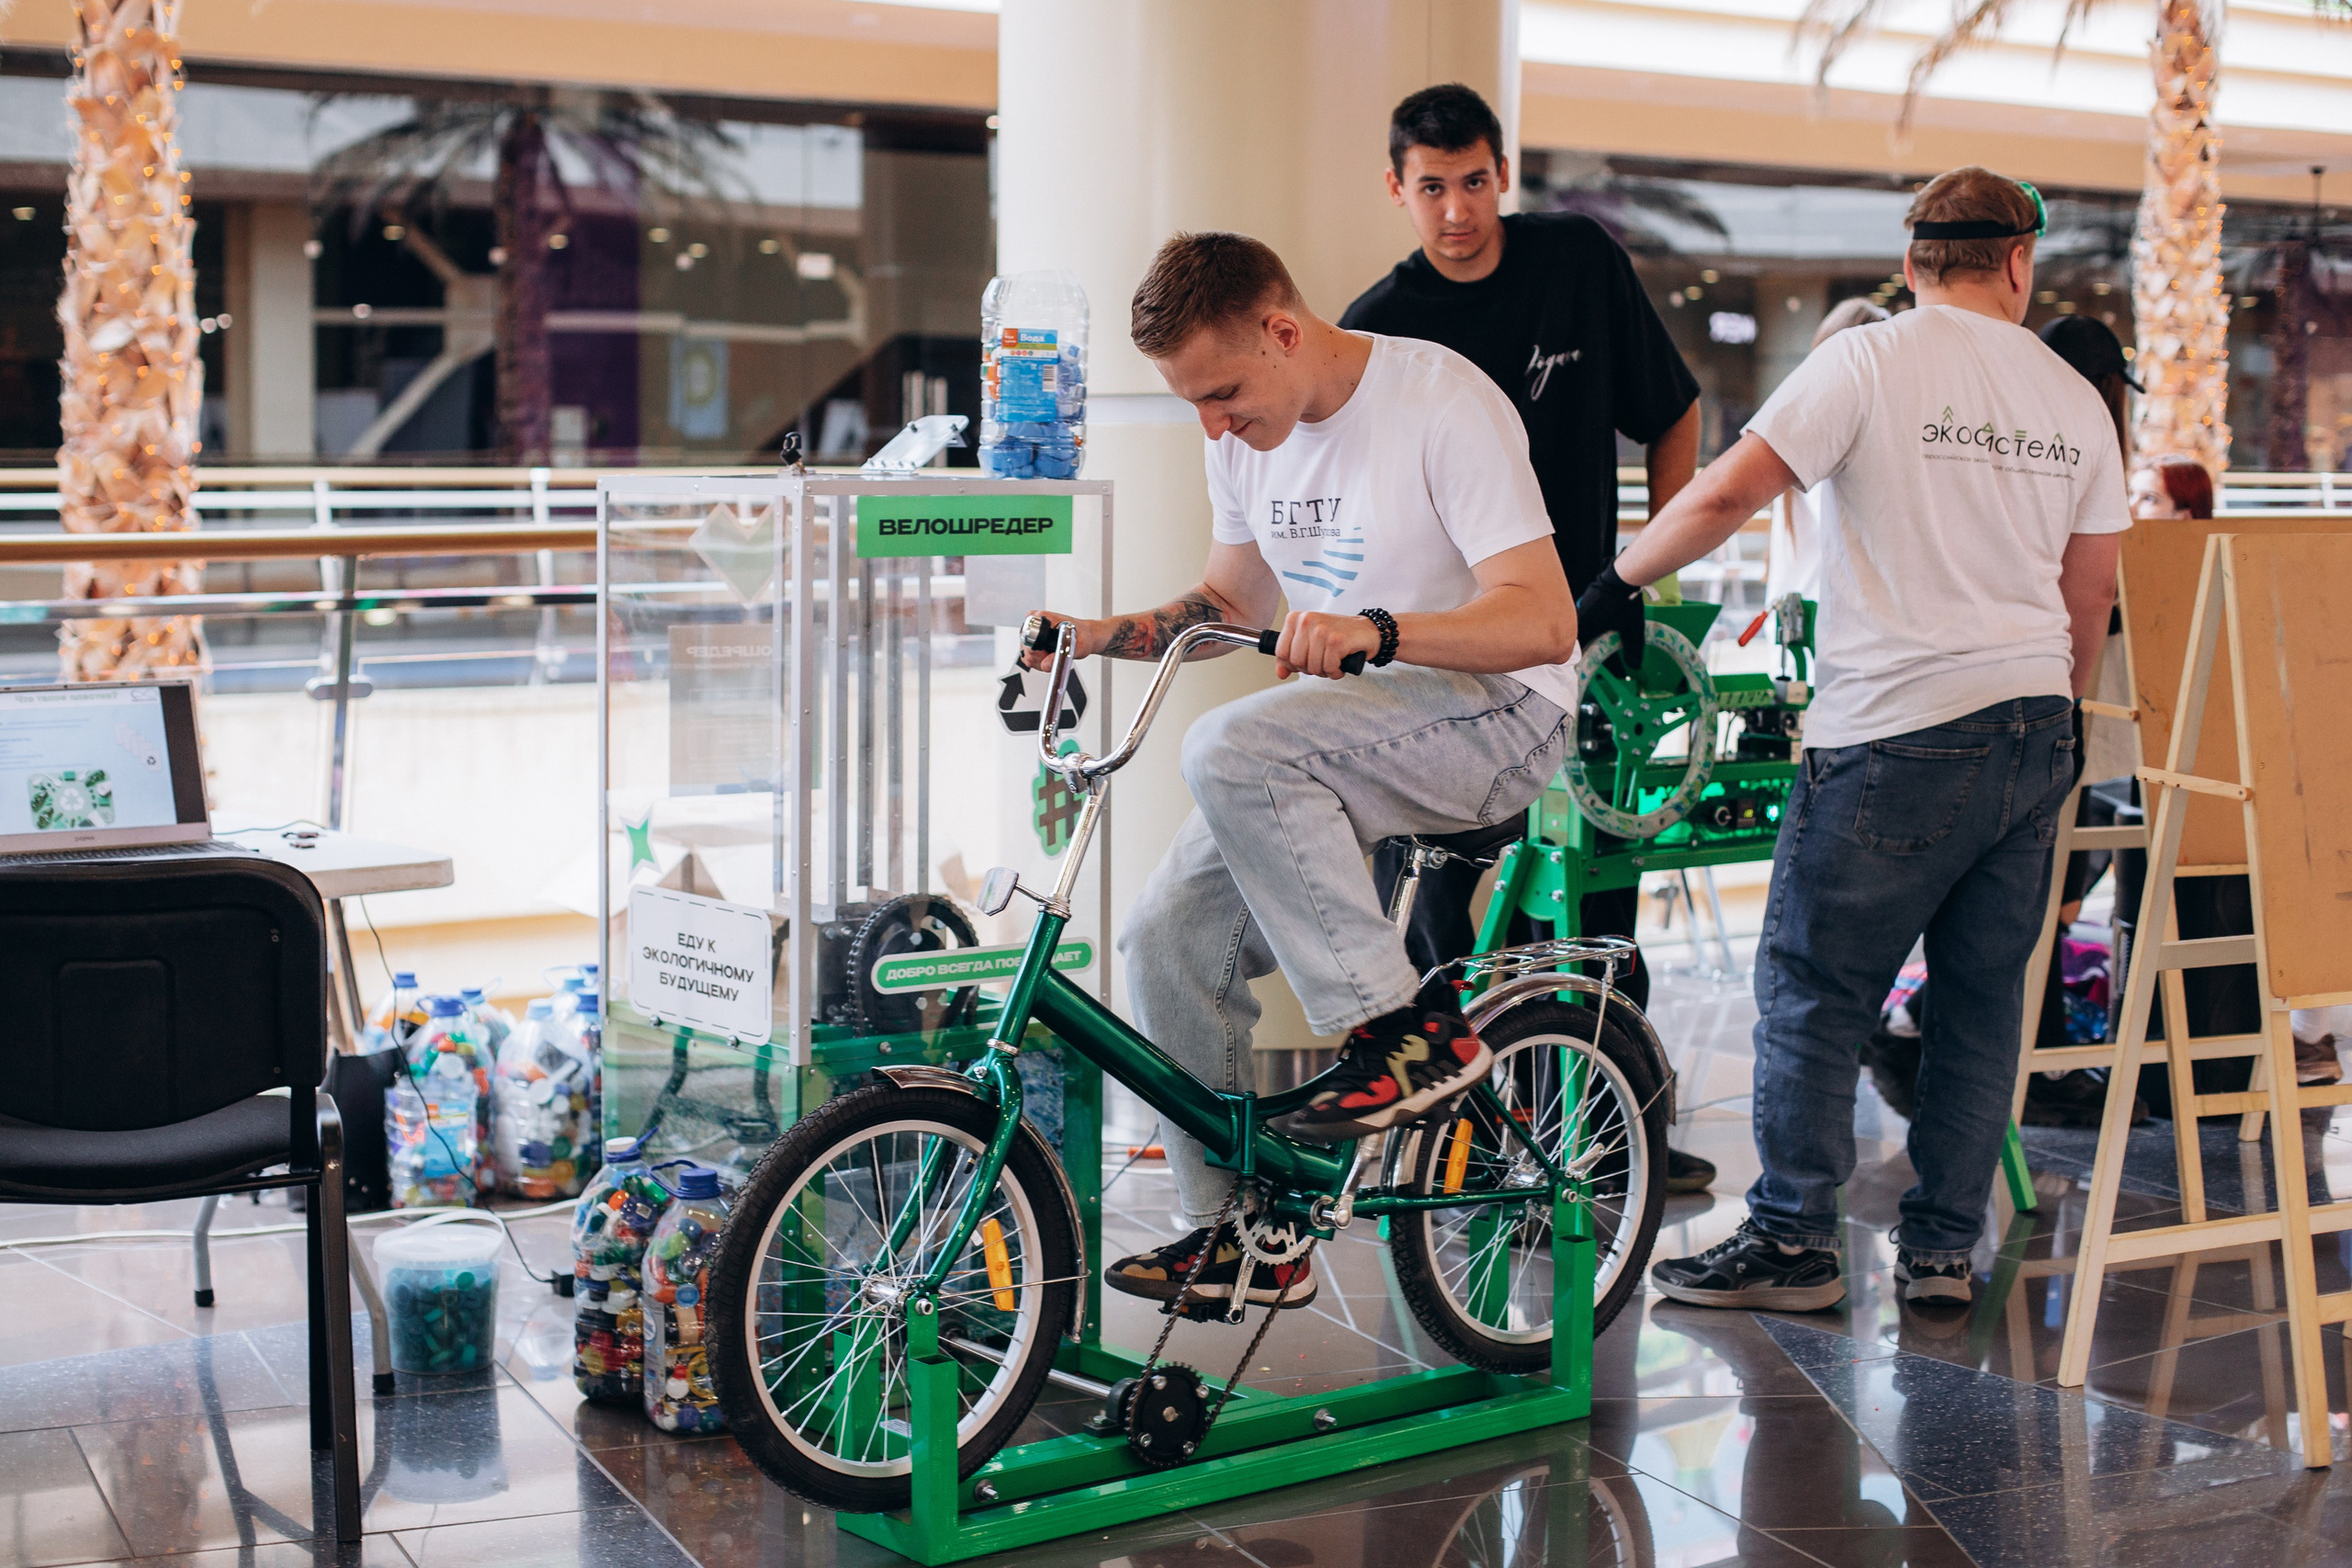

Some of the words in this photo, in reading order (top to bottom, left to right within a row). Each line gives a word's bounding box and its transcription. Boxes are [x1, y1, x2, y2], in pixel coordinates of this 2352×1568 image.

[1020, 333, 1045, 343] Вода
[1271, 498, 1341, 525] БГТУ
[879, 517, 1053, 536] ВЕЛОШРЕДЕР
[1272, 530, 1287, 539] им.
[678, 932, 704, 949] ЕДУ
[708, 939, 717, 953] К
[643, 946, 754, 983] ЭКОЛОГИЧНОМУ
[886, 965, 935, 981] ДОБРО
[937, 960, 993, 975] ВСЕГДА
[995, 950, 1082, 968] ПОБАЕТ
[660, 971, 740, 1001] БУДУЩЕМУ
